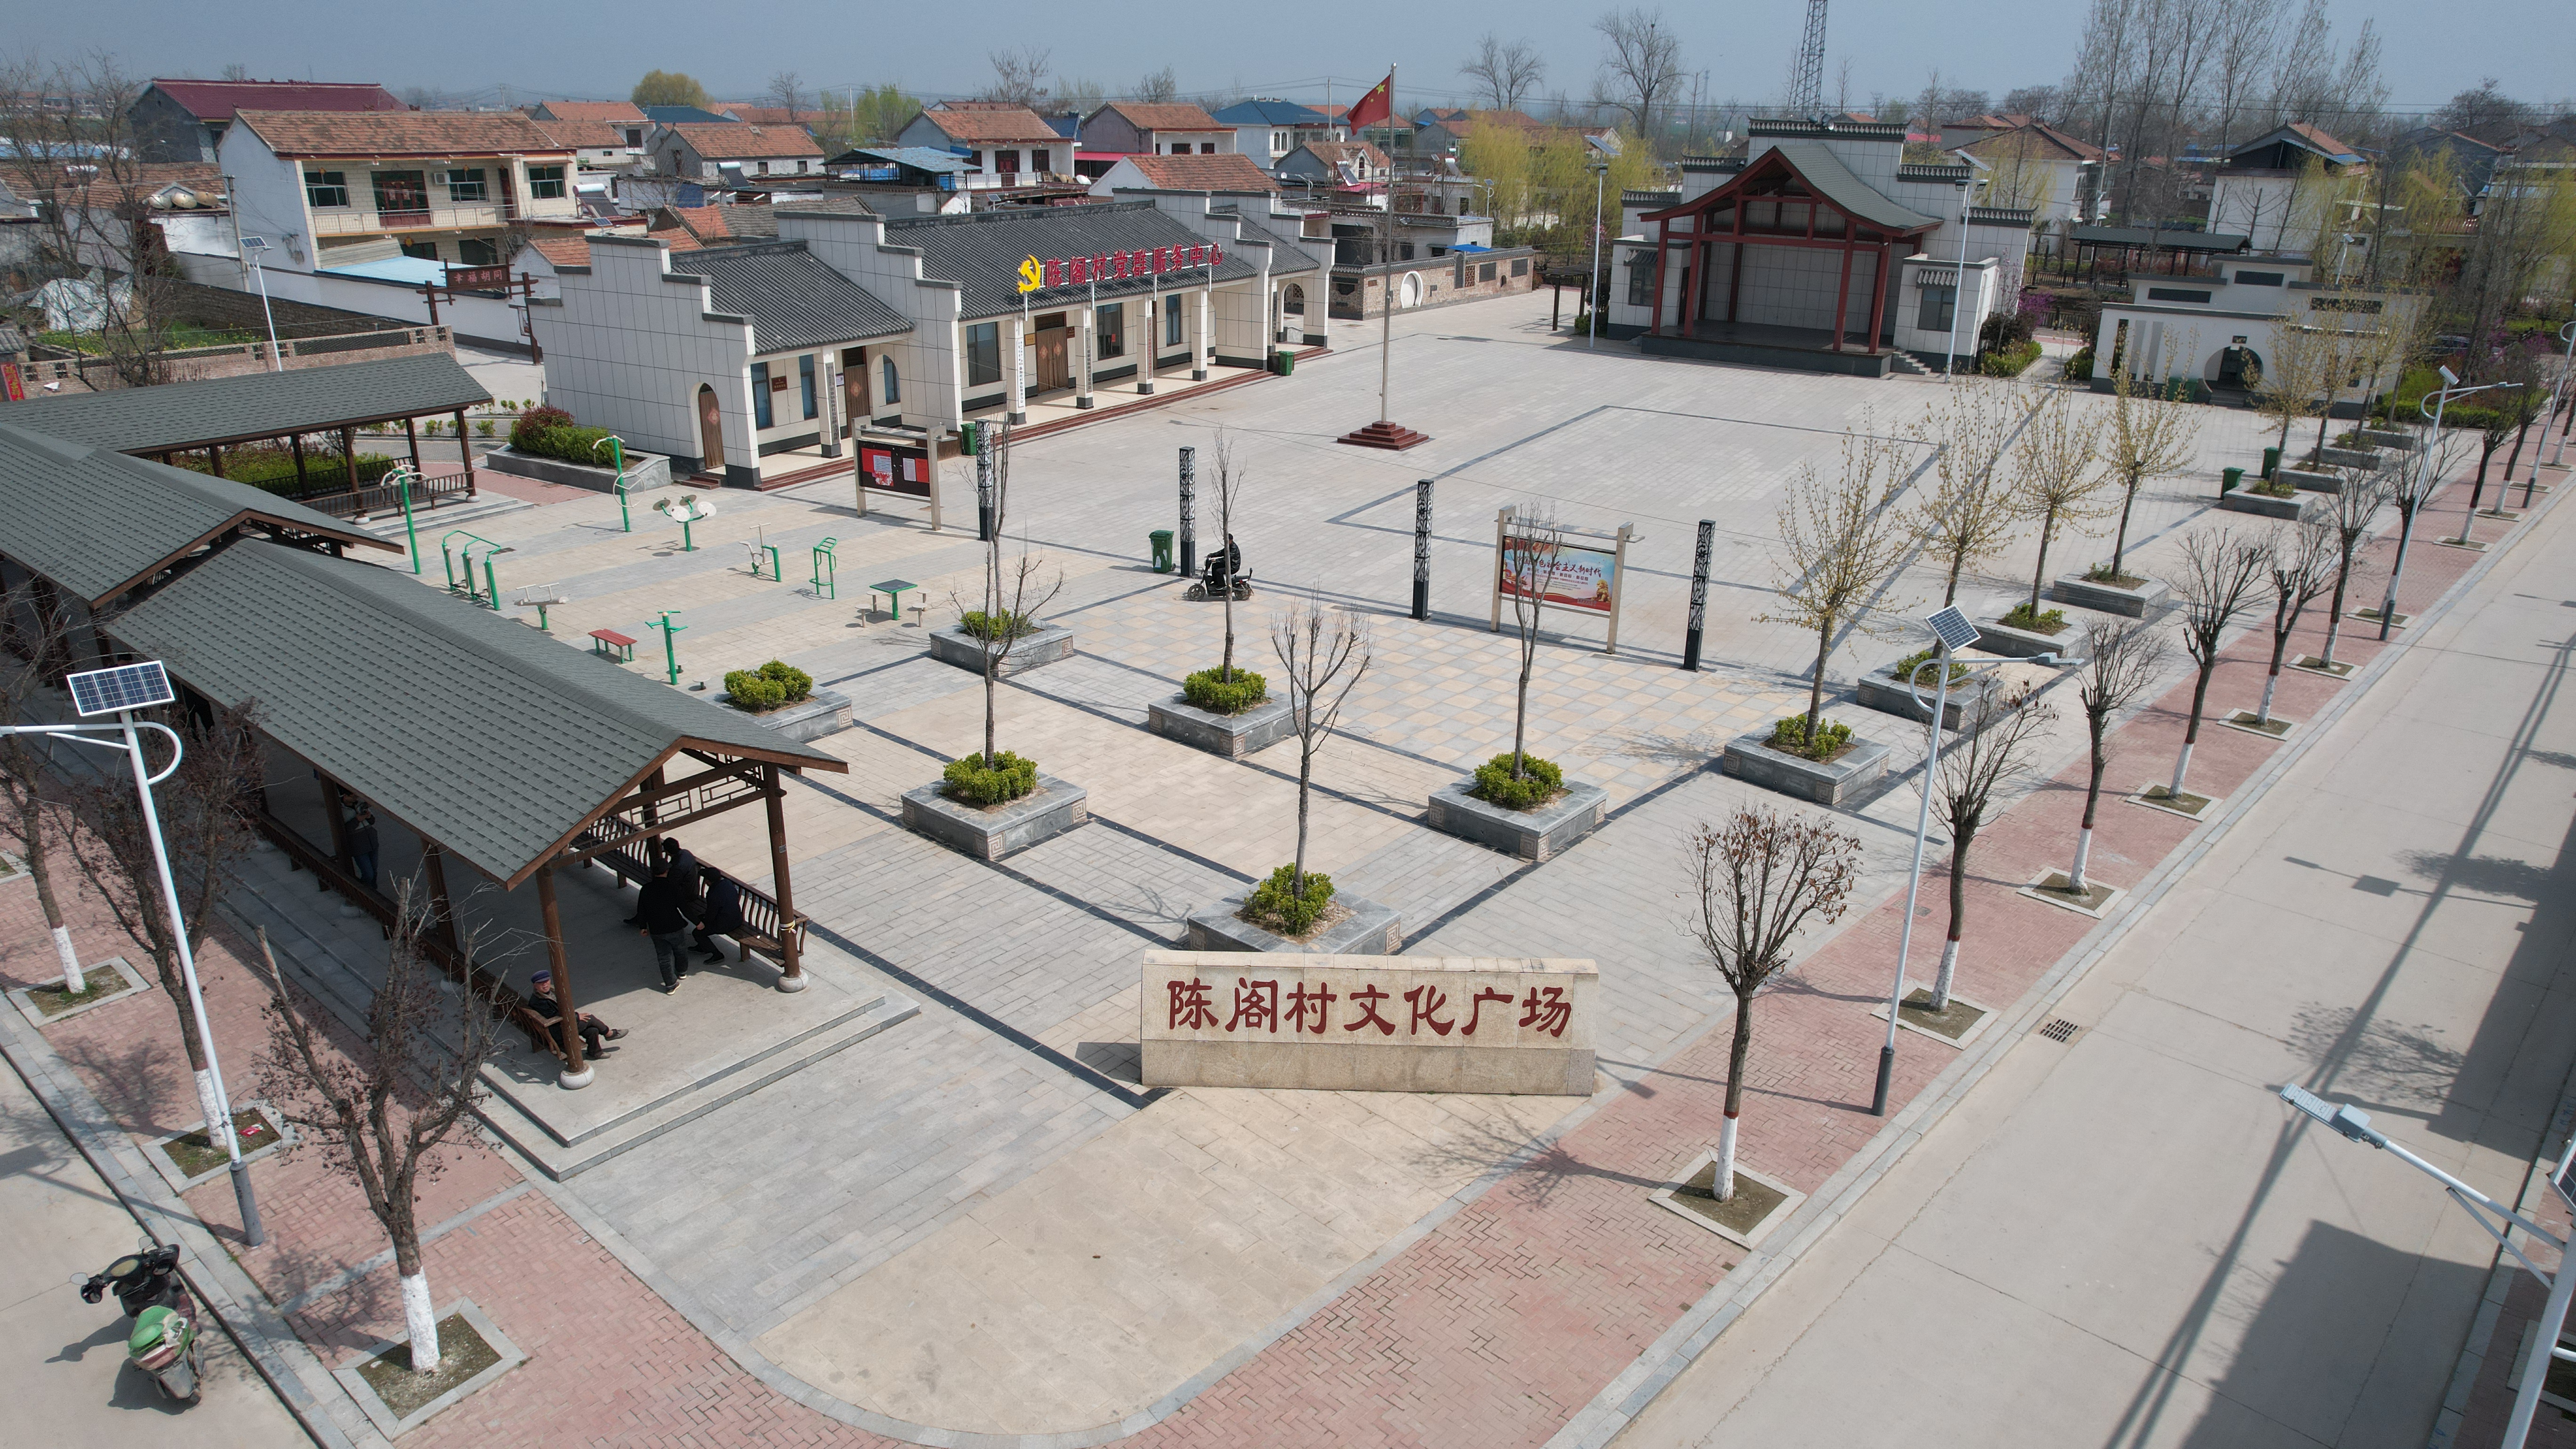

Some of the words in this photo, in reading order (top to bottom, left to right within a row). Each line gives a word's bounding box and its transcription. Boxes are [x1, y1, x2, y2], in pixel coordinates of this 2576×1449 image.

[454, 270, 502, 283] 幸福胡同
[1045, 242, 1223, 289] 陈阁村党群服务中心
[1517, 555, 1602, 578] 中国色社会主义新时代
[1167, 977, 1572, 1038] 陈阁村文化广场
